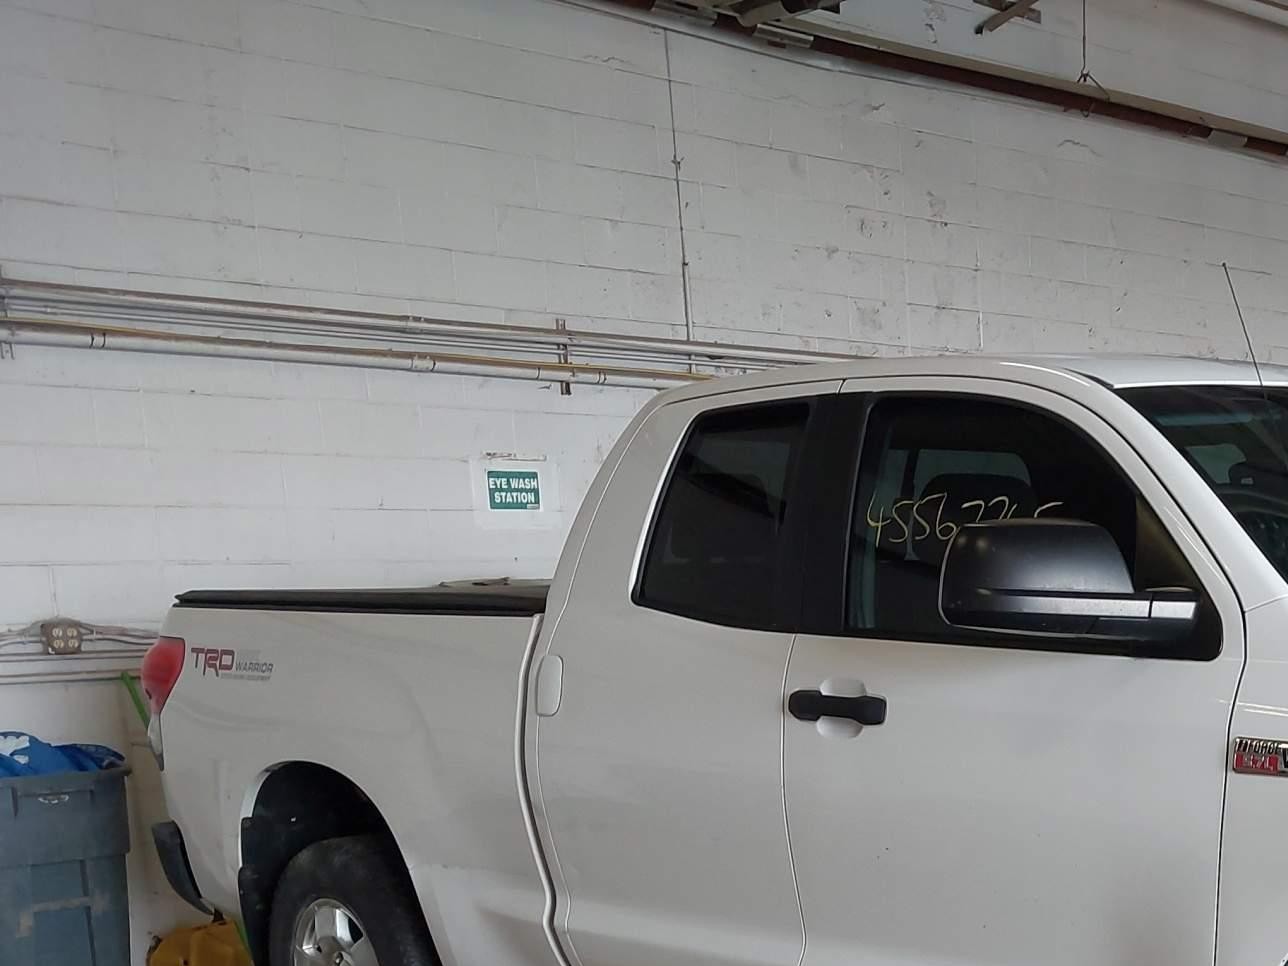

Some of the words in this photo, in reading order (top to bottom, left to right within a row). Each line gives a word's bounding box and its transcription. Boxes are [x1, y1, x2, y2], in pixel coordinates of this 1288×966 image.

[489, 477, 508, 489] EYE
[509, 477, 538, 489] WASH
[494, 491, 535, 503] STATION
[866, 488, 1065, 548] 455677
[190, 647, 235, 678] TRD
[235, 660, 274, 674] WARRIOR
